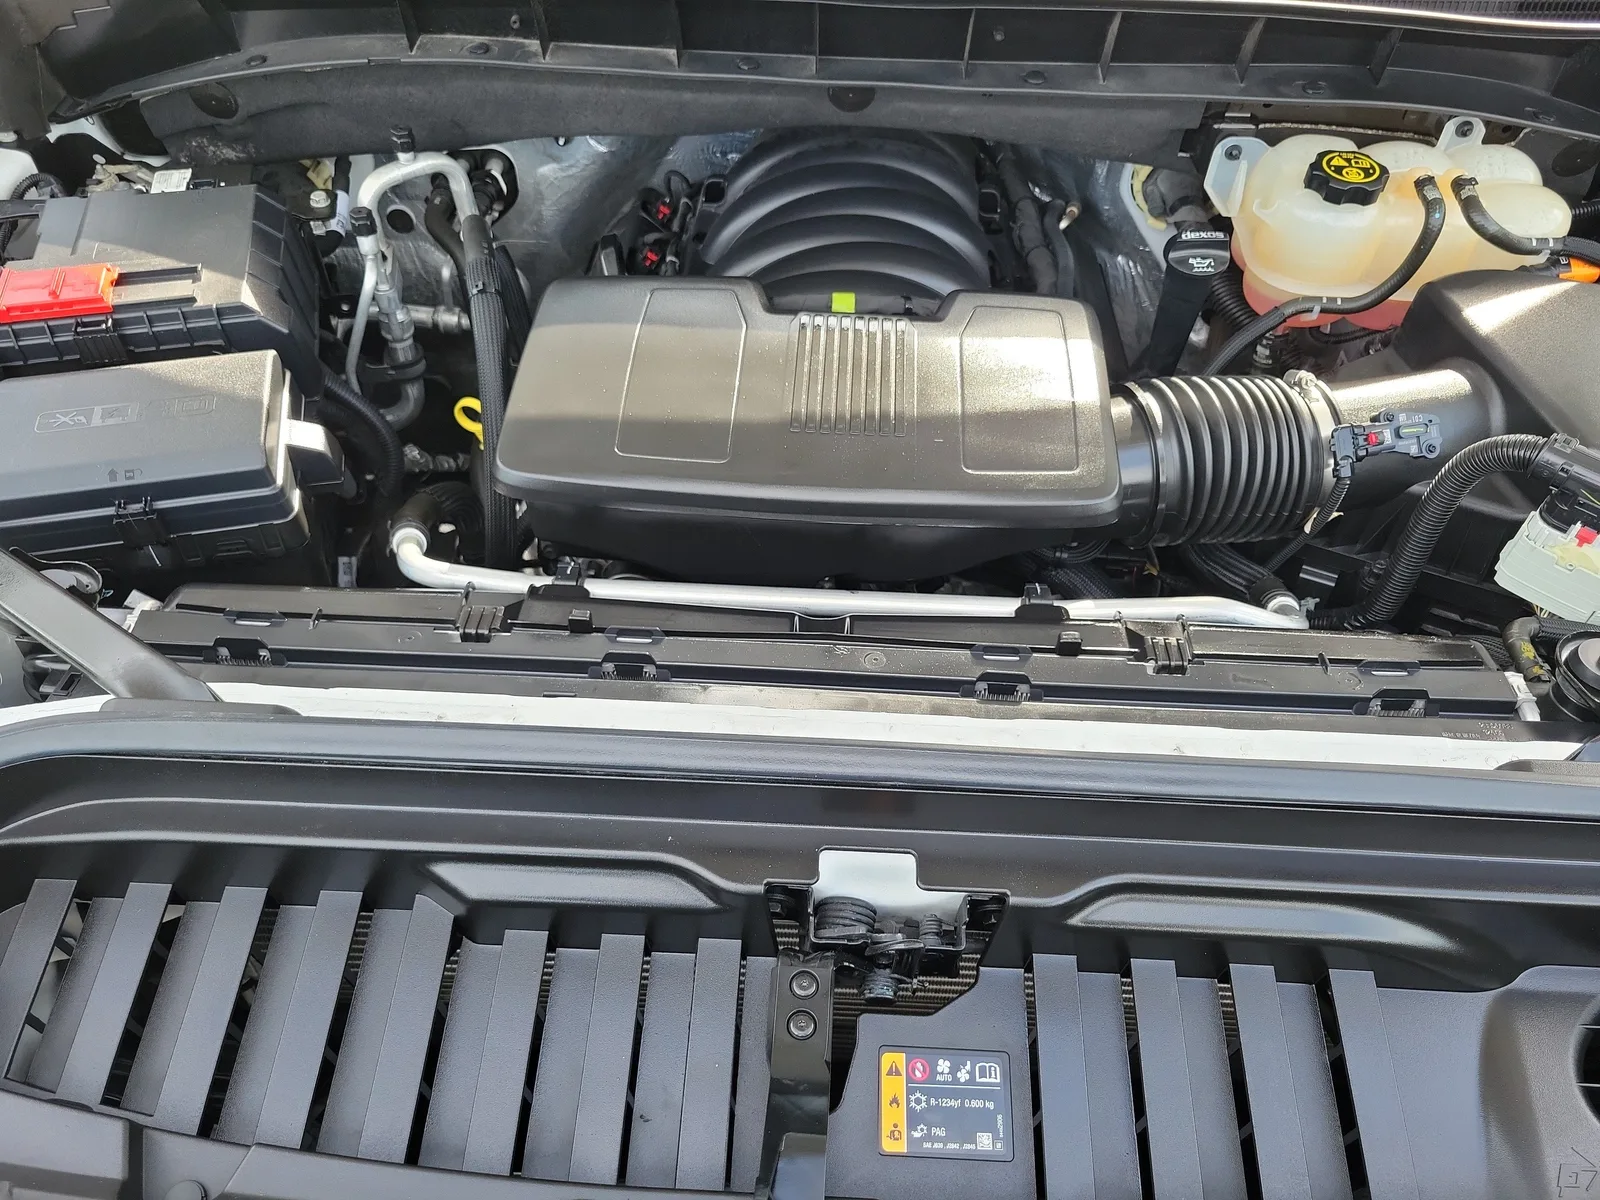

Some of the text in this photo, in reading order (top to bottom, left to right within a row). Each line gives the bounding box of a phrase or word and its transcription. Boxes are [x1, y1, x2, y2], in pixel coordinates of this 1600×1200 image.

[1181, 229, 1225, 239] dexos
[930, 1098, 994, 1109] R-1234yf 0.600 kg
[931, 1127, 946, 1136] PAG
